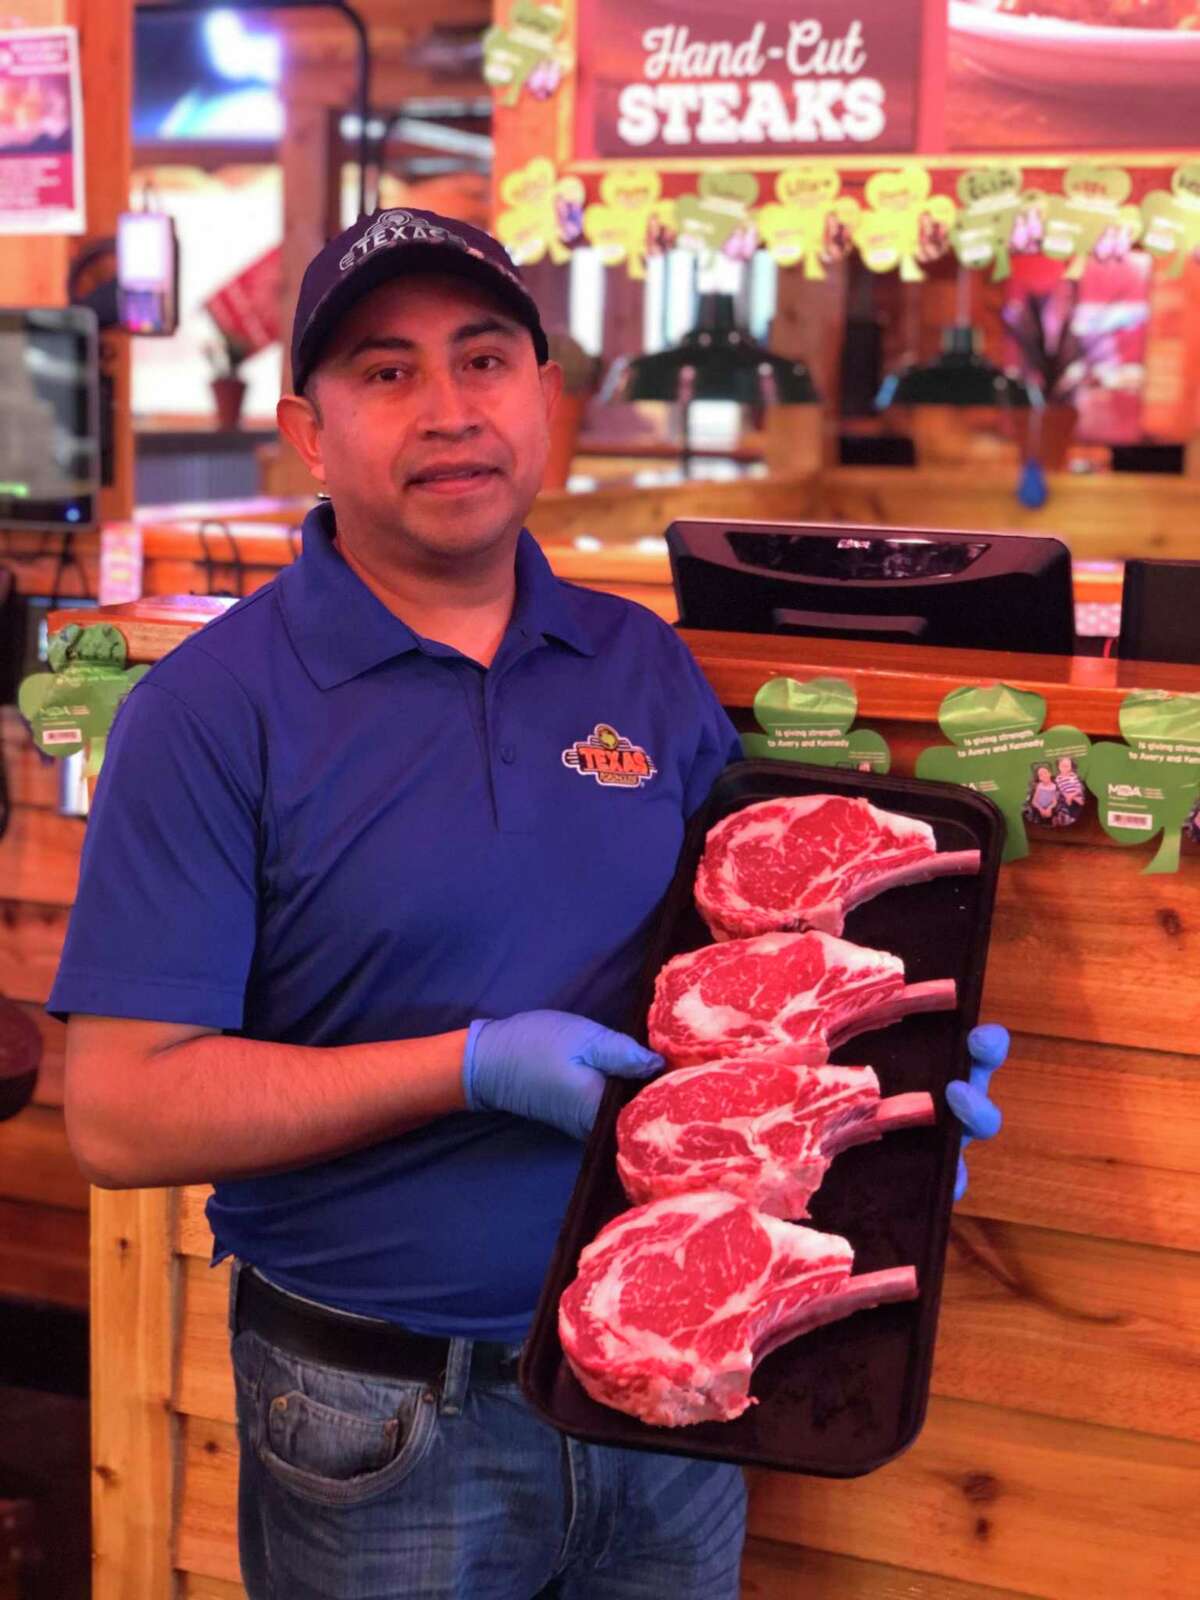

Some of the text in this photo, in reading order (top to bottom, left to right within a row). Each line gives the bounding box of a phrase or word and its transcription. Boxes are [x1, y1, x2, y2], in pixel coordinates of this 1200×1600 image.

[642, 19, 867, 80] Hand-Cut
[617, 77, 886, 146] STEAKS
[357, 226, 446, 254] TEXAS
[578, 747, 648, 776] TEXAS
[992, 744, 1008, 754] and
